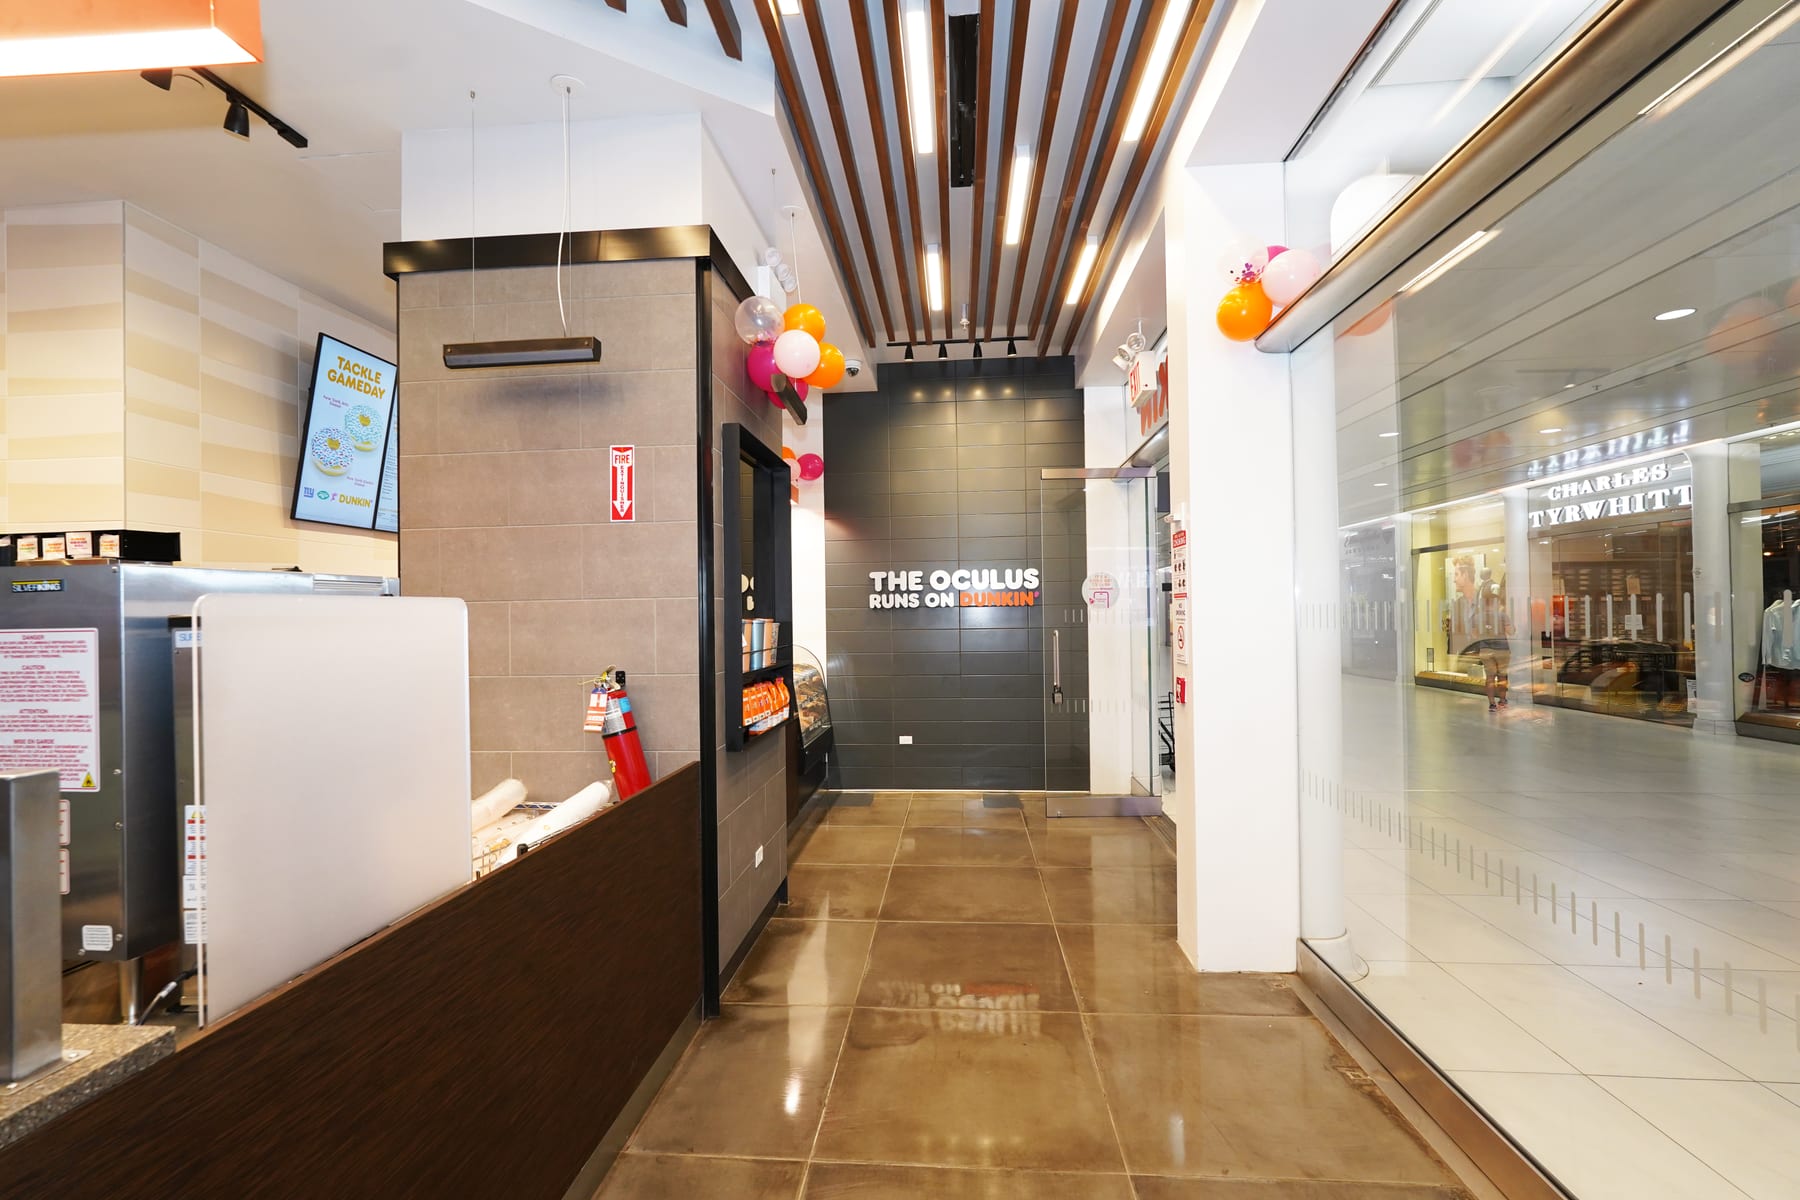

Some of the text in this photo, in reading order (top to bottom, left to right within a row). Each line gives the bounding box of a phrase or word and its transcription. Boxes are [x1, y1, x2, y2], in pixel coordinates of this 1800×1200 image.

[327, 369, 386, 399] GAMEDAY
[337, 356, 382, 384] TACKLE
[614, 454, 630, 464] FIRE
[1548, 463, 1668, 501] CHARLES
[1529, 484, 1693, 528] TYRWHITT
[868, 568, 1040, 592] THE OCULUS
[868, 591, 1040, 609] RUNS ON DUNKIN'
